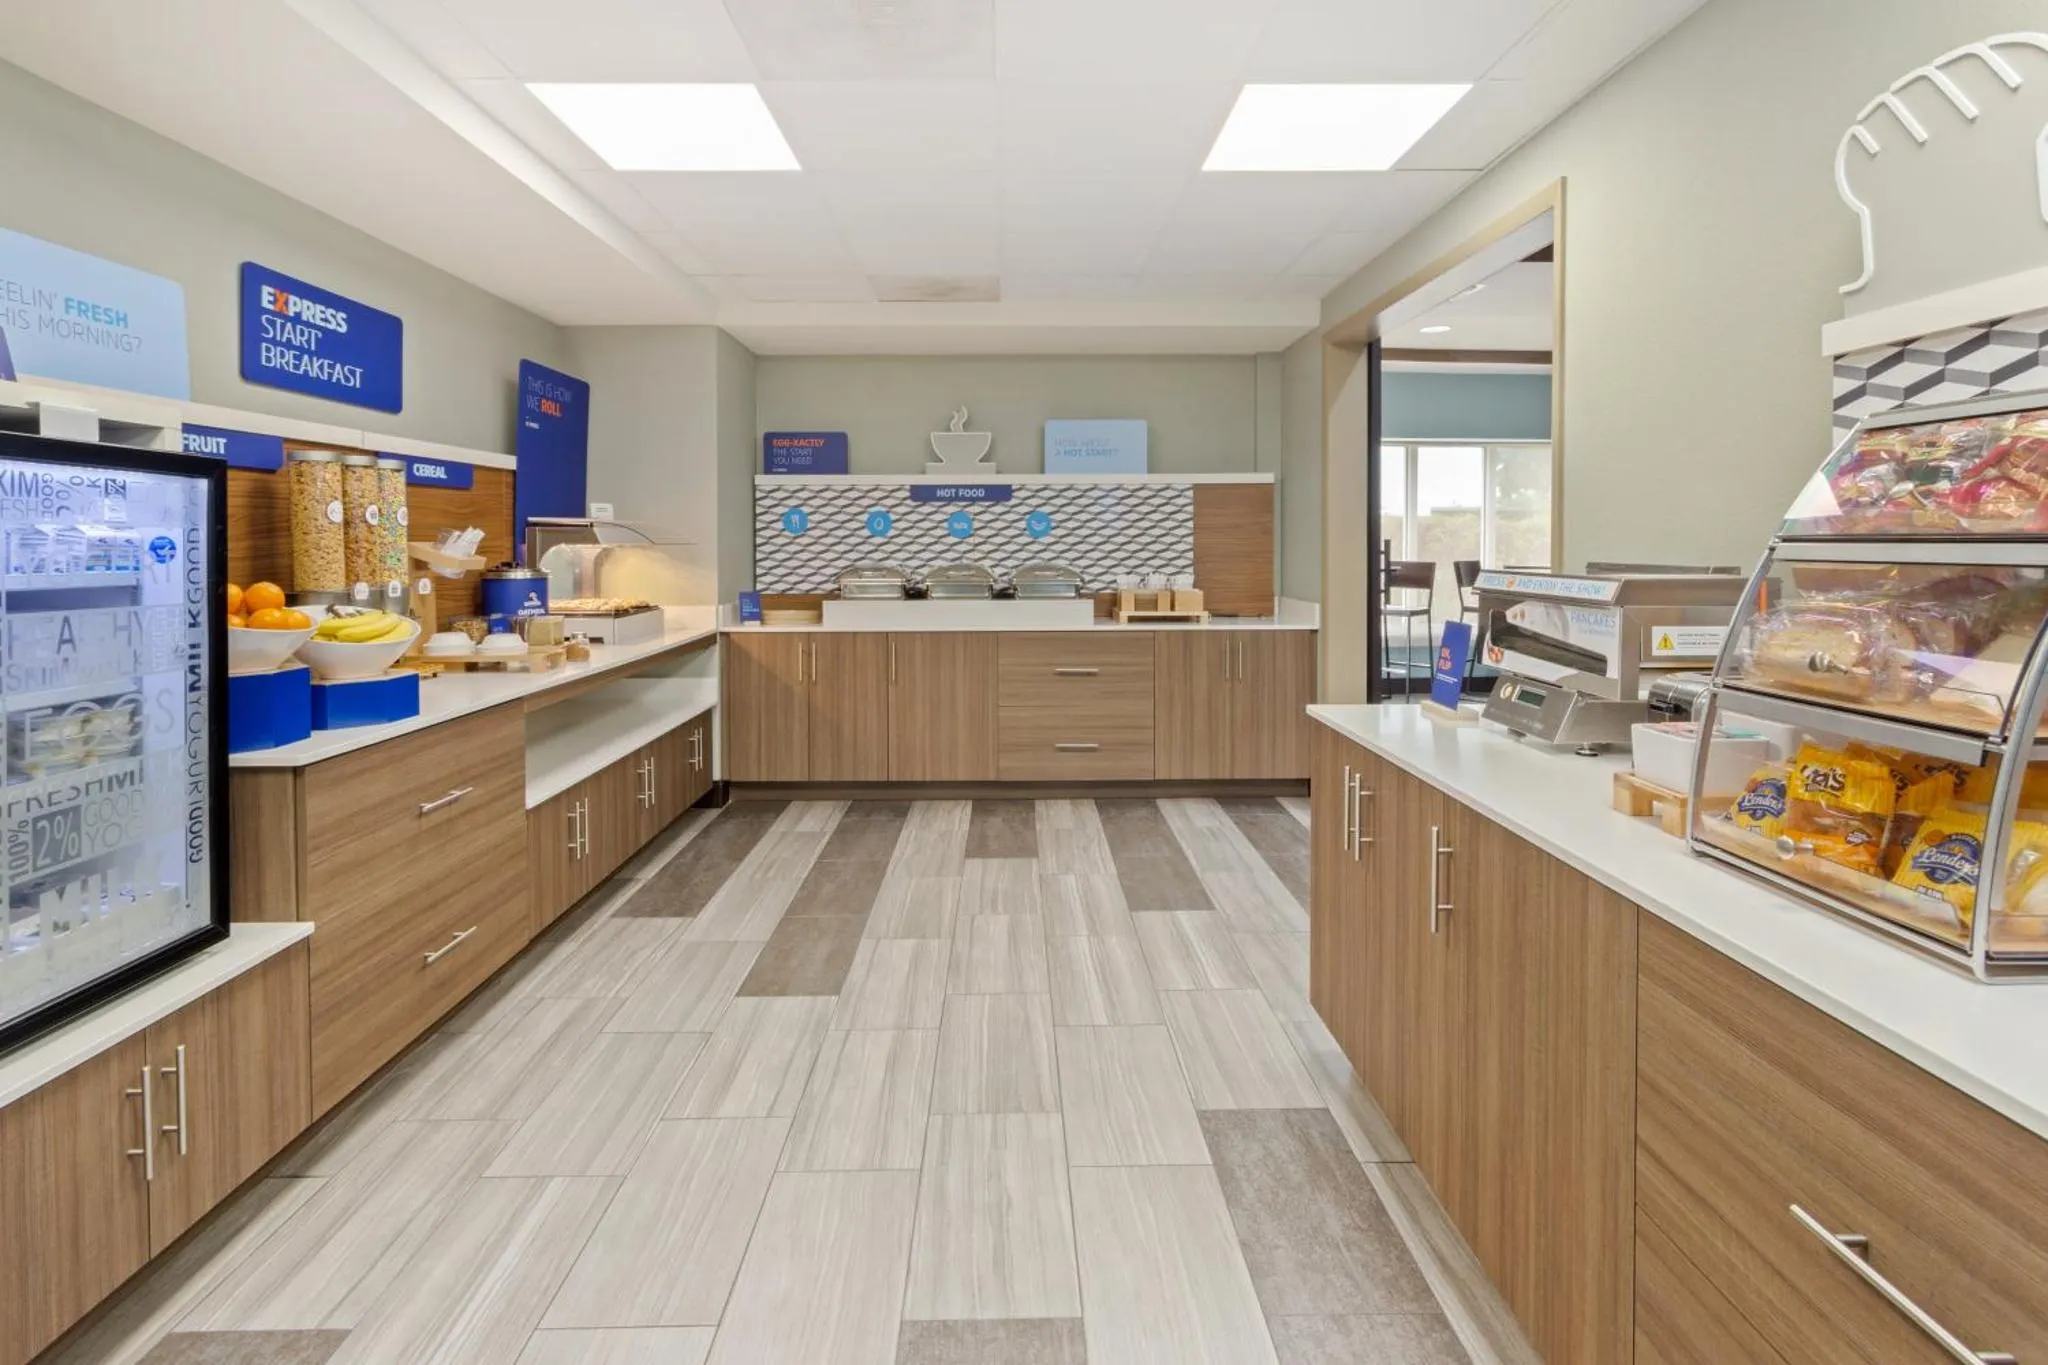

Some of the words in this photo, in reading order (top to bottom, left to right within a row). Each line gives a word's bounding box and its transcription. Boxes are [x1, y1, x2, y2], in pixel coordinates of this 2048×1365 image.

[63, 297, 129, 329] FRESH
[261, 284, 348, 334] EXPRESS
[38, 313, 142, 353] MORNING?
[261, 314, 322, 351] START
[261, 342, 364, 388] BREAKFAST
[541, 398, 562, 418] ROLL
[182, 433, 227, 454] FRUIT
[1064, 447, 1082, 457] HOT
[413, 463, 448, 479] CEREAL
[936, 487, 956, 498] HOT
[959, 487, 985, 498] FOOD
[36, 810, 80, 867] 2%
